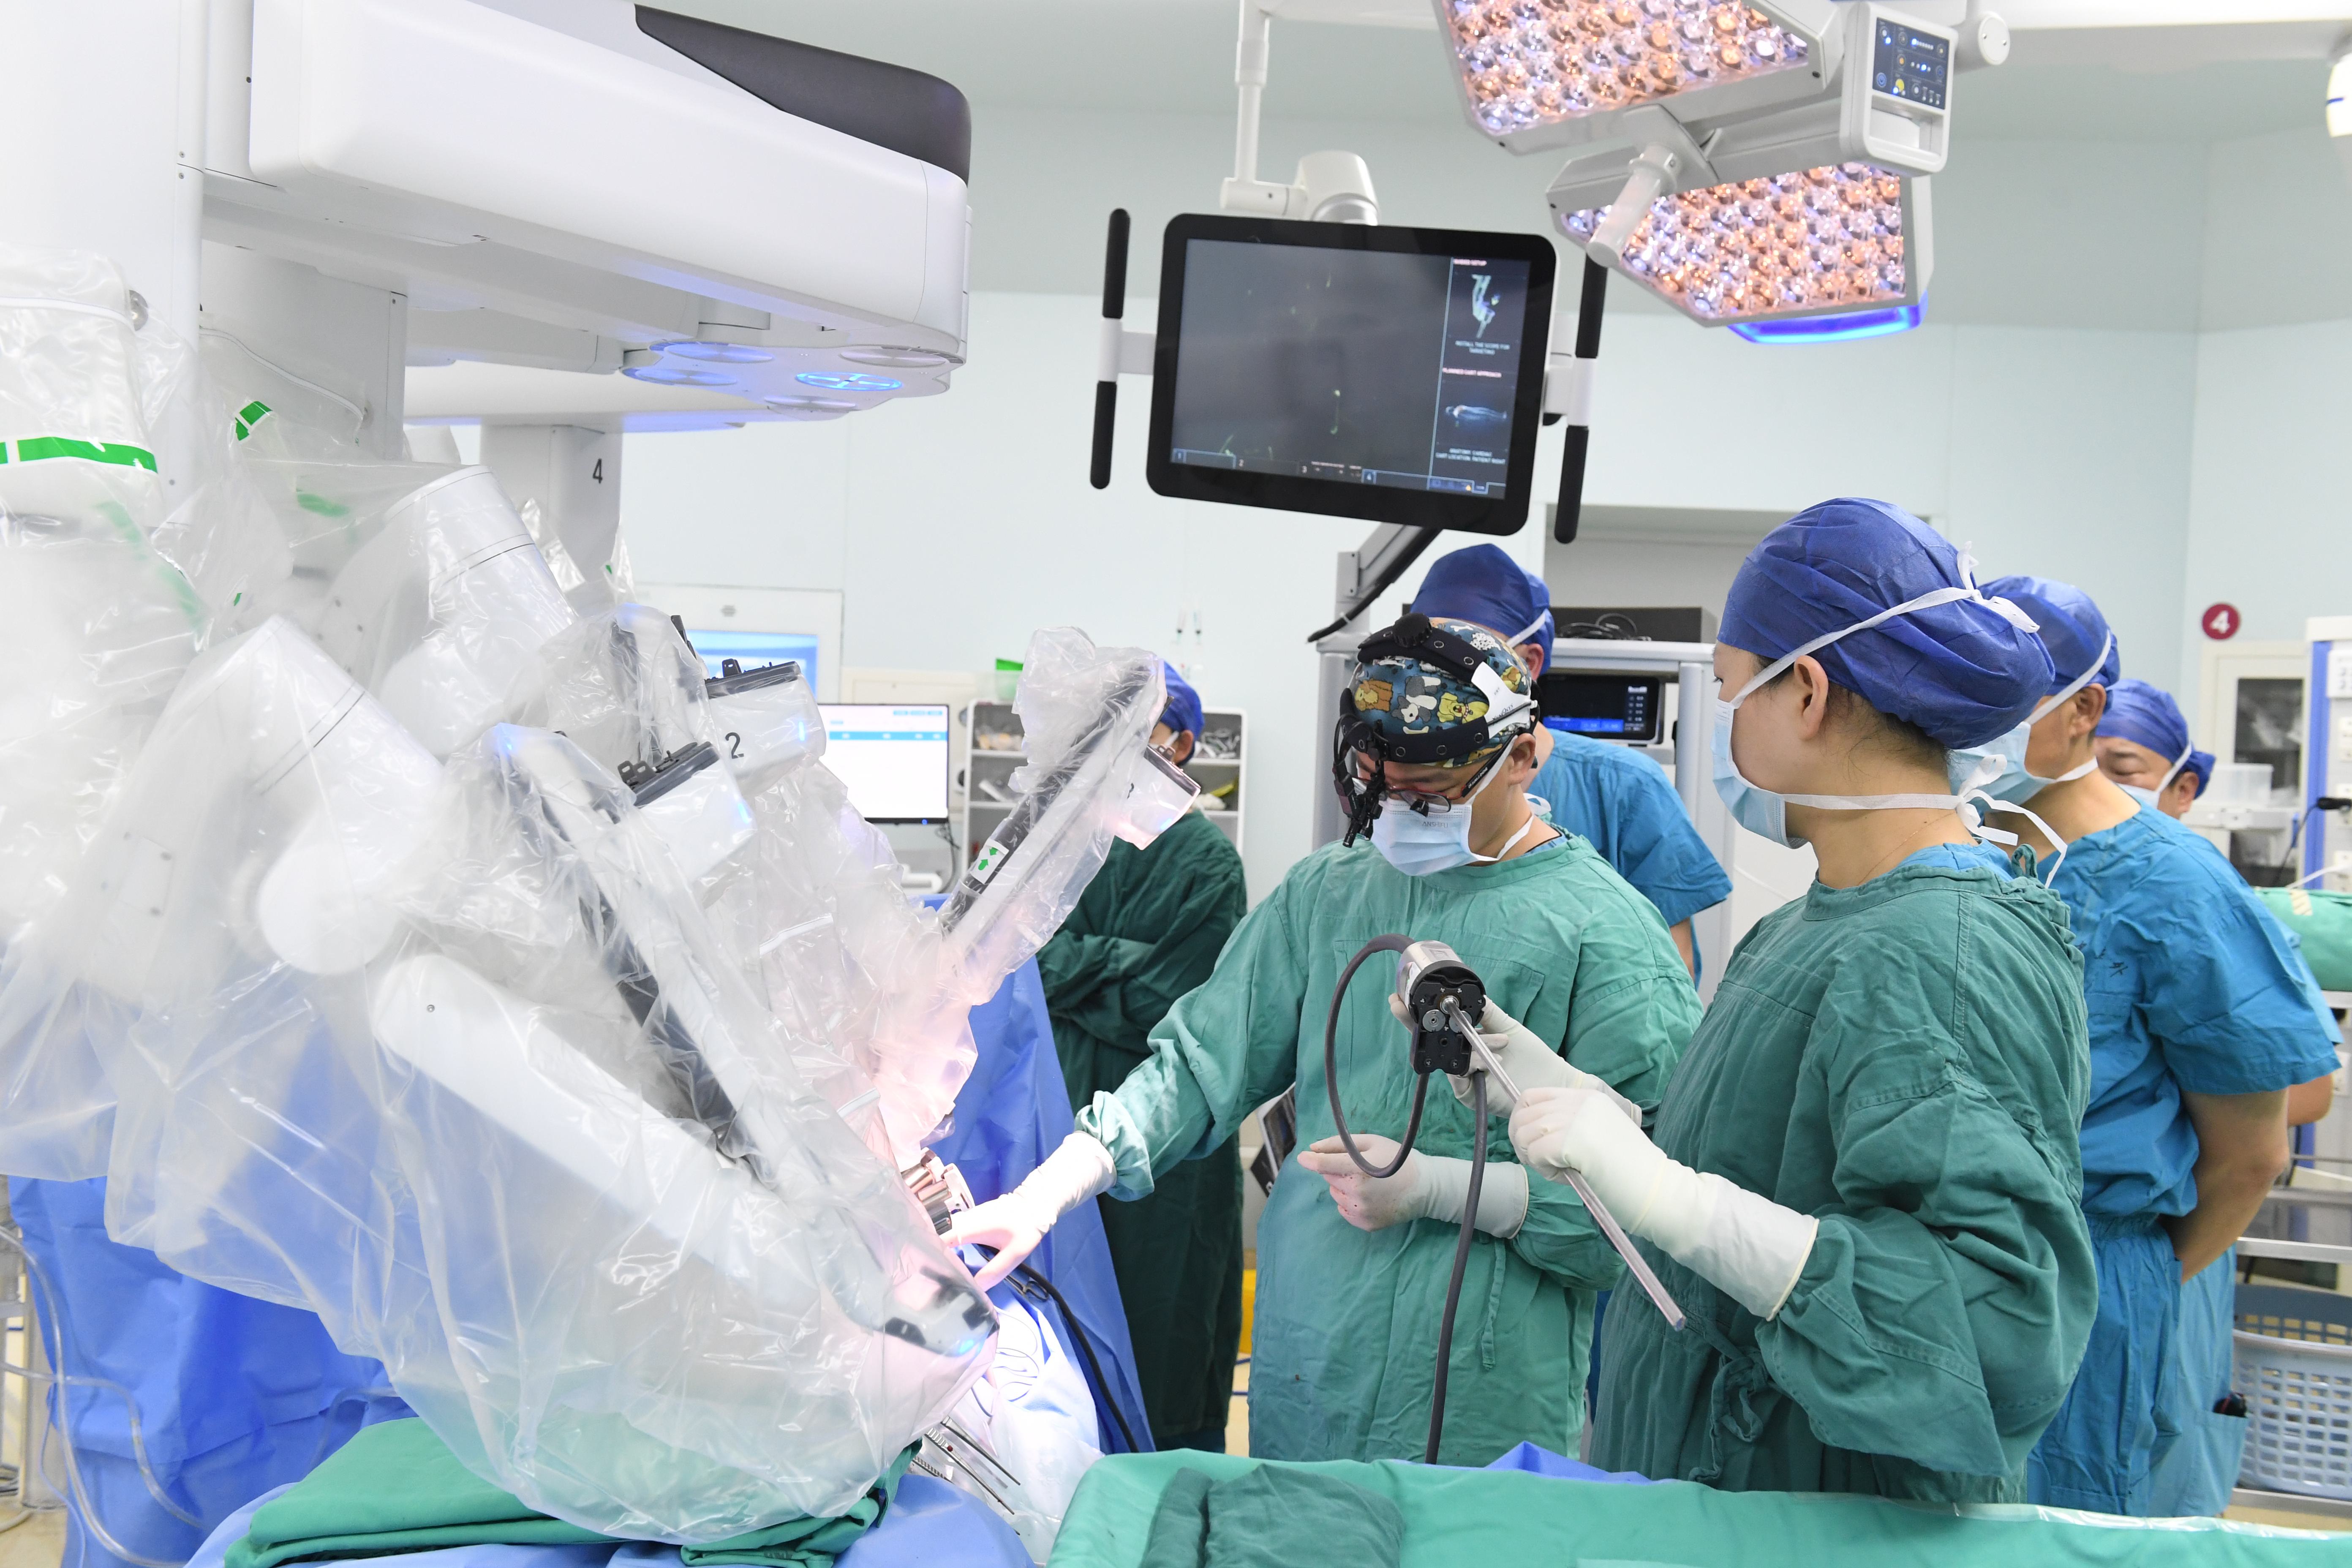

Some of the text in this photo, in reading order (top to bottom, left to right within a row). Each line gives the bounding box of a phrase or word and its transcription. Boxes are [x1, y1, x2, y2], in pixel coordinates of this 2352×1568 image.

[592, 458, 602, 484] 4
[2210, 610, 2230, 634] 4
[725, 732, 744, 760] 2
